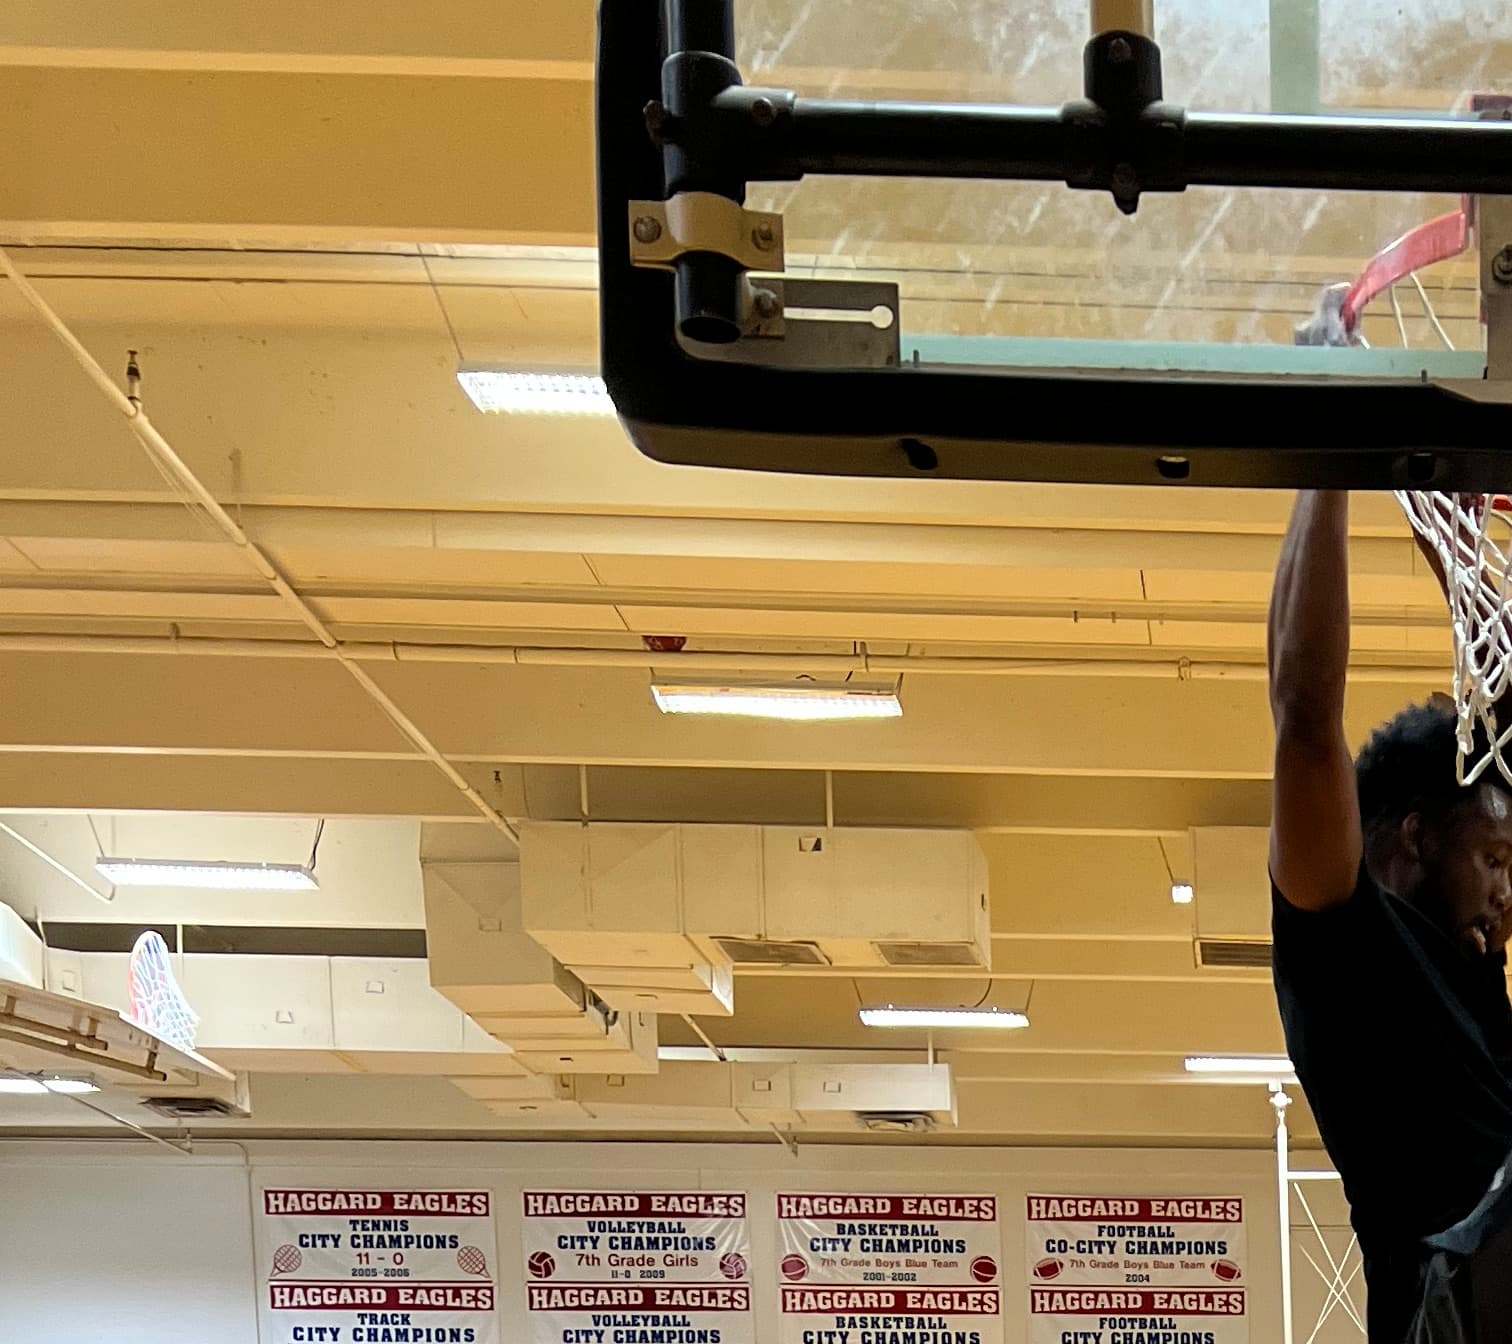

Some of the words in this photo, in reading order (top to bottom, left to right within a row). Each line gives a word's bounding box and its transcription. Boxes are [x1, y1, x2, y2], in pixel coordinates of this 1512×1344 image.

[268, 1193, 382, 1215] HAGGARD
[393, 1193, 487, 1215] EAGLES
[527, 1195, 642, 1217] HAGGARD
[652, 1195, 745, 1217] EAGLES
[781, 1198, 891, 1220] HAGGARD
[902, 1198, 994, 1220] EAGLES
[1030, 1199, 1139, 1221] HAGGARD
[1150, 1199, 1240, 1221] EAGLES
[349, 1220, 408, 1232] TENNIS
[587, 1221, 685, 1233] VOLLEYBALL
[837, 1223, 938, 1236] BASKETBALL
[1098, 1225, 1175, 1238] FOOTBALL
[299, 1234, 341, 1248] CITY
[351, 1234, 458, 1249] CHAMPIONS
[558, 1235, 600, 1249] CITY
[609, 1236, 715, 1250] CHAMPIONS
[810, 1238, 851, 1252] CITY
[860, 1239, 965, 1253] CHAMPIONS
[1046, 1239, 1116, 1254] CO-CITY
[1126, 1241, 1227, 1255] CHAMPIONS
[356, 1252, 369, 1265] 11
[393, 1252, 403, 1265] 0
[576, 1254, 600, 1266] 7th
[608, 1254, 655, 1266] Grade
[663, 1254, 698, 1267] Girls
[820, 1258, 836, 1267] 7th
[841, 1258, 871, 1267] Grade
[875, 1259, 901, 1268] Boys
[905, 1259, 927, 1268] Blue
[932, 1259, 958, 1268] Team
[1070, 1259, 1085, 1268] 7th
[1089, 1259, 1119, 1268] Grade
[1124, 1260, 1149, 1270] Boys
[1153, 1260, 1174, 1269] Blue
[1179, 1261, 1205, 1269] Team
[352, 1268, 409, 1277] 2005-2006
[640, 1270, 665, 1278] 2009
[863, 1272, 916, 1281] 2001-2002
[1126, 1274, 1150, 1282] 2004
[273, 1288, 387, 1309] HAGGARD
[398, 1288, 492, 1309] EAGLES
[531, 1289, 644, 1310] HAGGARD
[655, 1289, 748, 1310] EAGLES
[785, 1291, 895, 1313] HAGGARD
[906, 1291, 997, 1313] EAGLES
[1033, 1293, 1142, 1314] HAGGARD
[1153, 1293, 1243, 1314] EAGLES
[357, 1313, 411, 1325] TRACK
[592, 1315, 690, 1327] VOLLEYBALL
[836, 1316, 947, 1329] BASKETBALL
[1100, 1317, 1176, 1329] FOOTBALL
[293, 1327, 340, 1341] CITY
[353, 1328, 474, 1342] CHAMPIONS
[563, 1330, 604, 1343] CITY
[614, 1330, 720, 1343] CHAMPIONS
[803, 1331, 849, 1344] CITY
